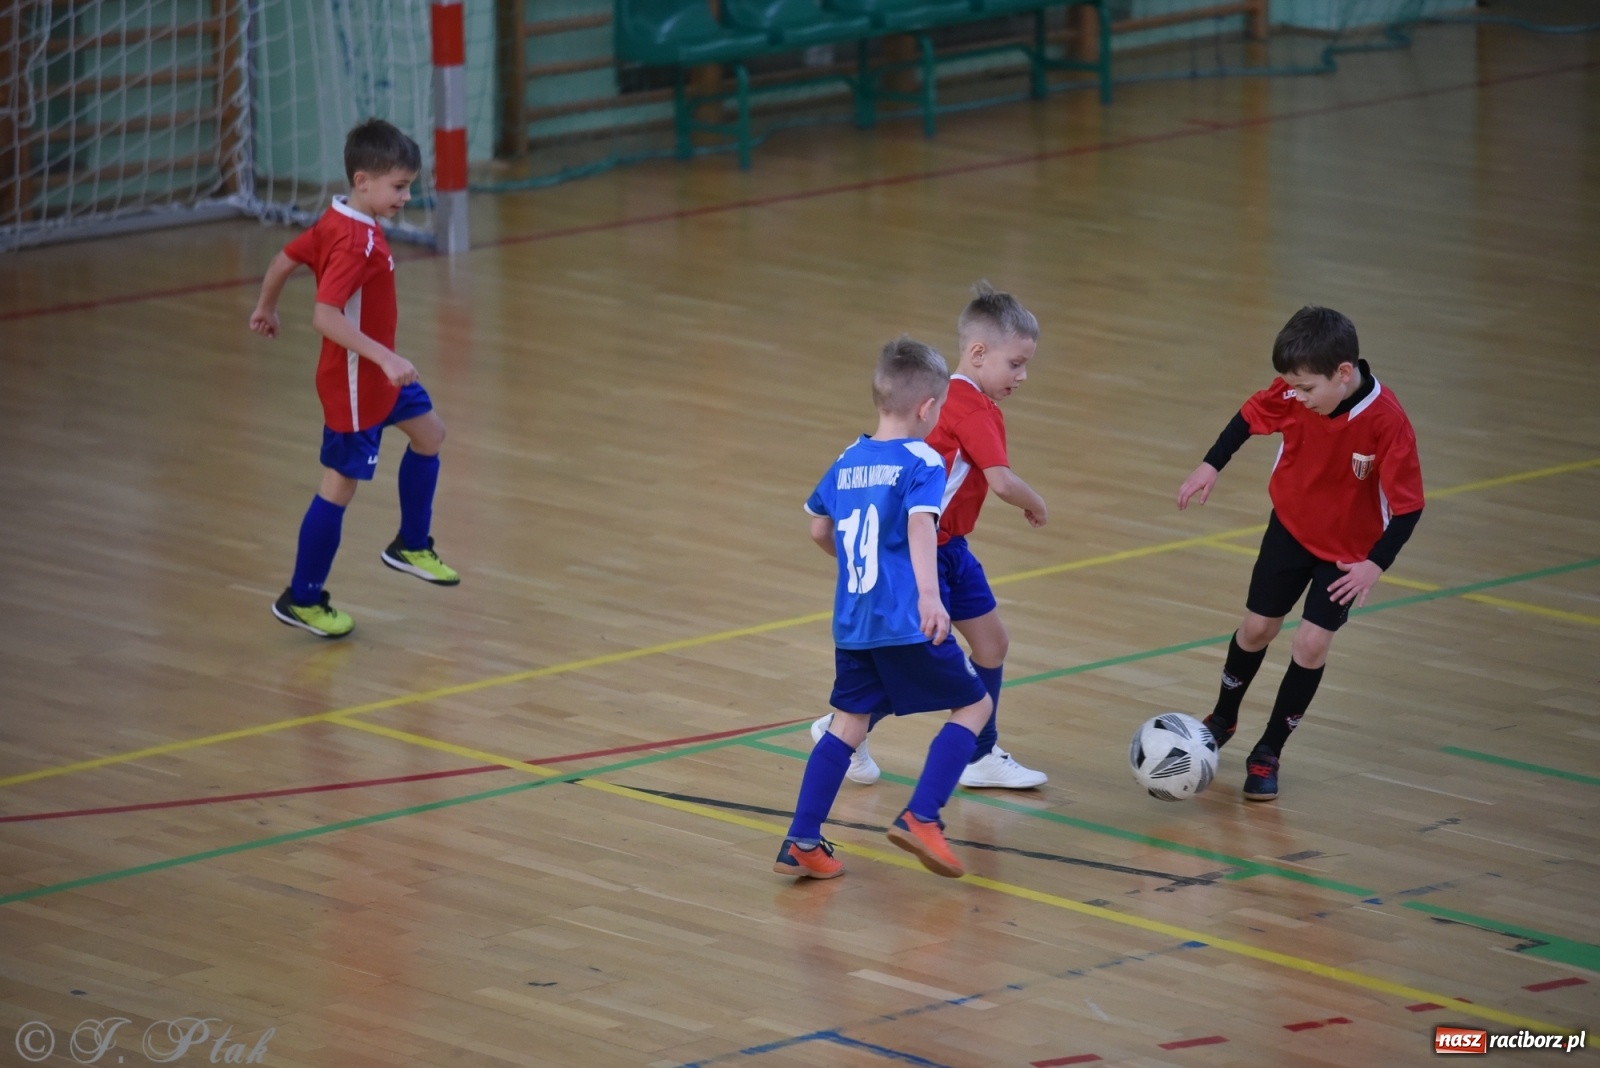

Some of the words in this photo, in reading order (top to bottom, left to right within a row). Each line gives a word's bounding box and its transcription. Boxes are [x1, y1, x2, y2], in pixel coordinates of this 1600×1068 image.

[837, 467, 852, 490] UKS
[851, 465, 868, 489] ARKA
[837, 503, 880, 594] 19
